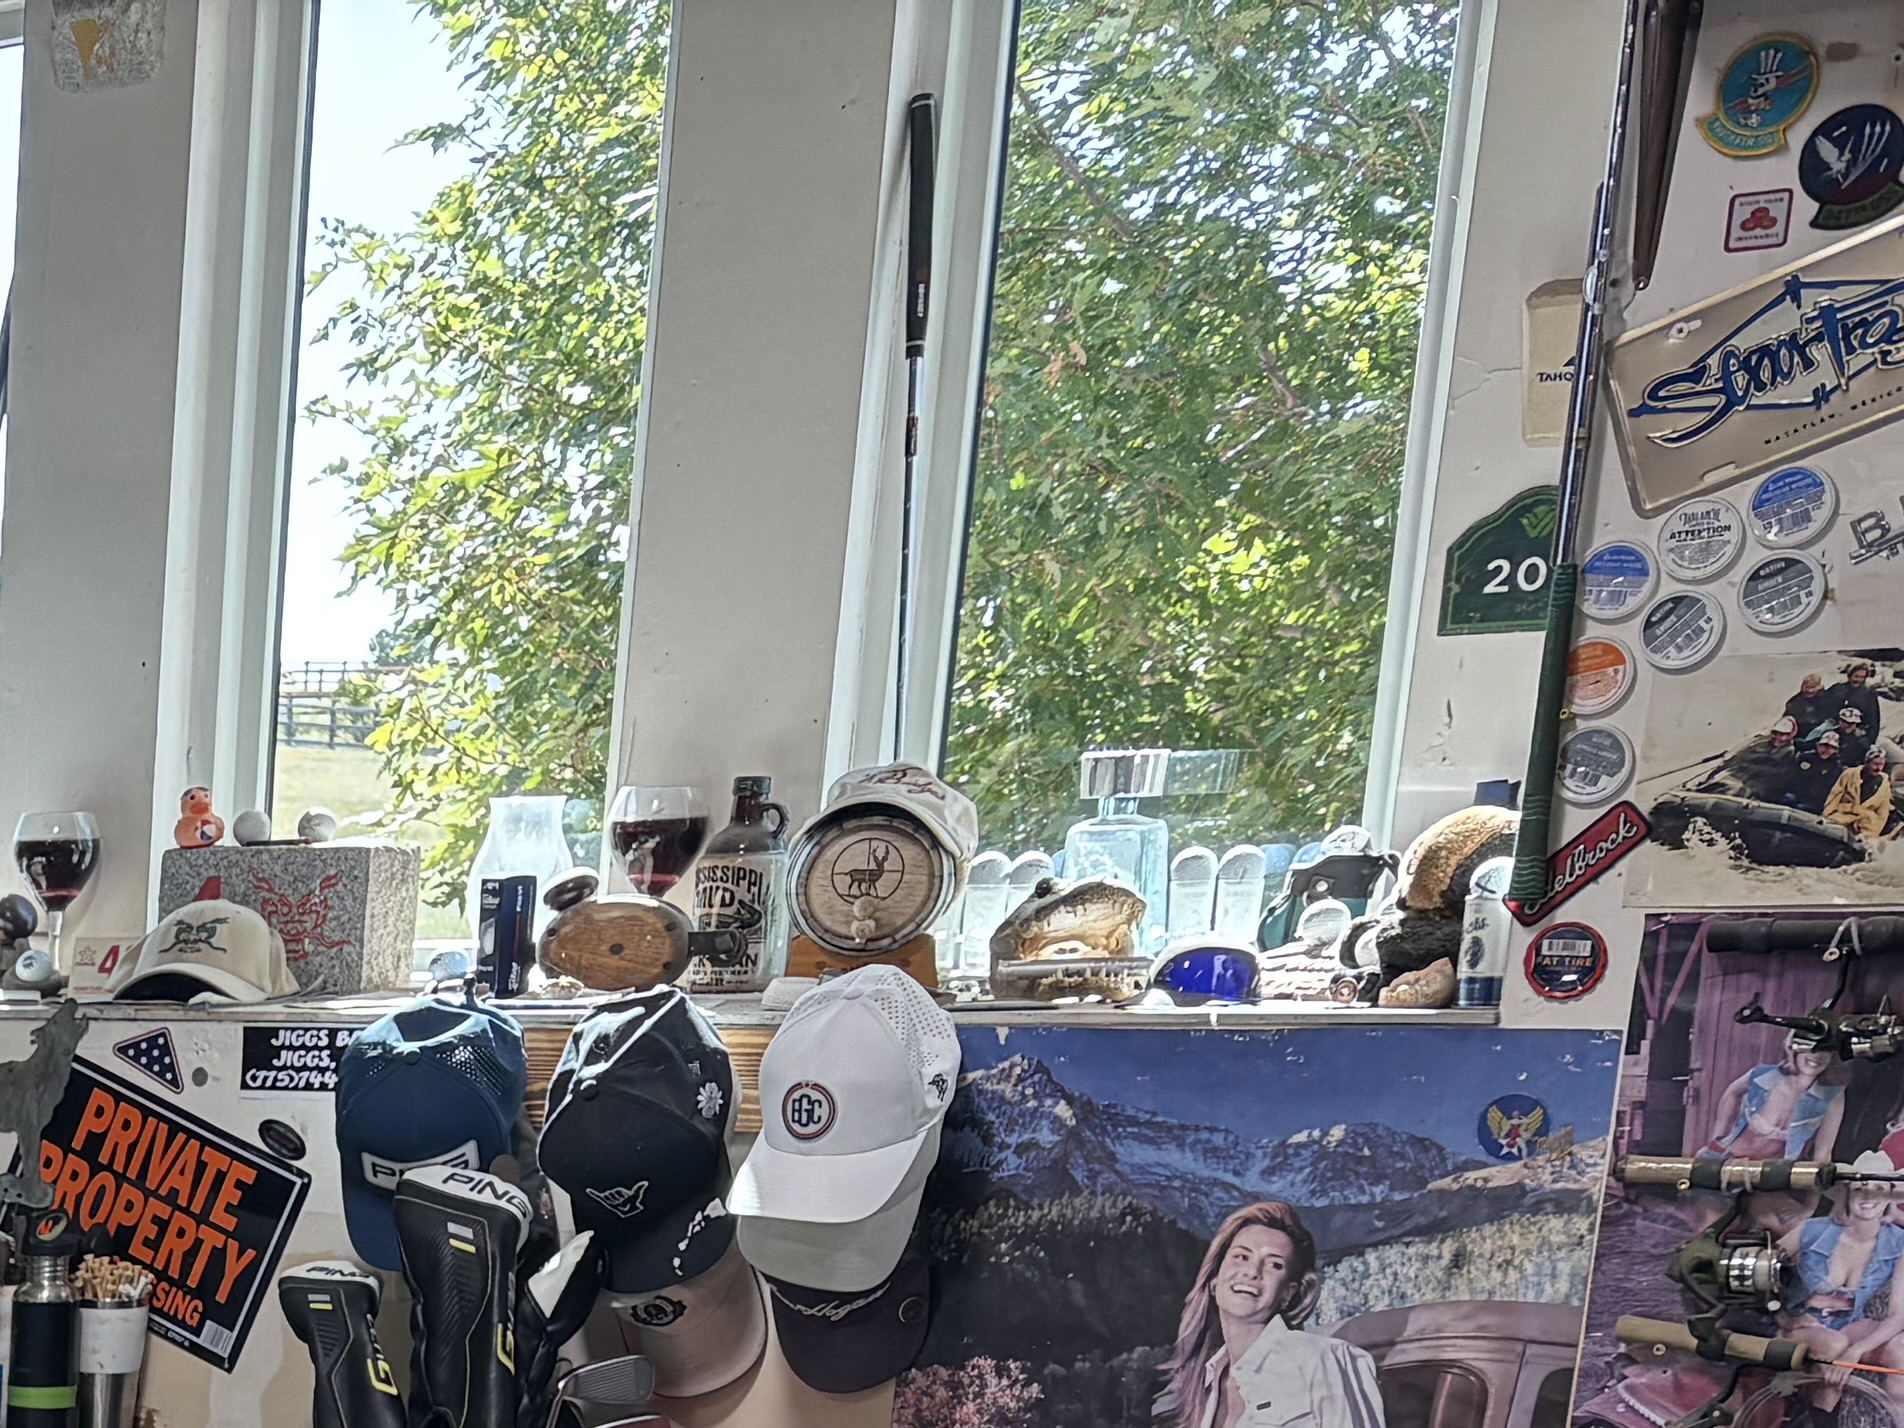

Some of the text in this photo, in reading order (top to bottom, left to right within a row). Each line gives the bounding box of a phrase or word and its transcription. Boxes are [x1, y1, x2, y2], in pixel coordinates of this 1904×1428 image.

[1537, 372, 1574, 384] TAHO
[1483, 556, 1547, 594] 20
[1564, 957, 1592, 967] TIRE
[271, 1029, 329, 1047] JIGGS
[272, 1050, 336, 1070] JIGGS,
[72, 1087, 257, 1232] PRIVATE
[442, 1171, 530, 1219] PING
[39, 1139, 257, 1304] PROPERTY
[306, 1266, 370, 1280] PING
